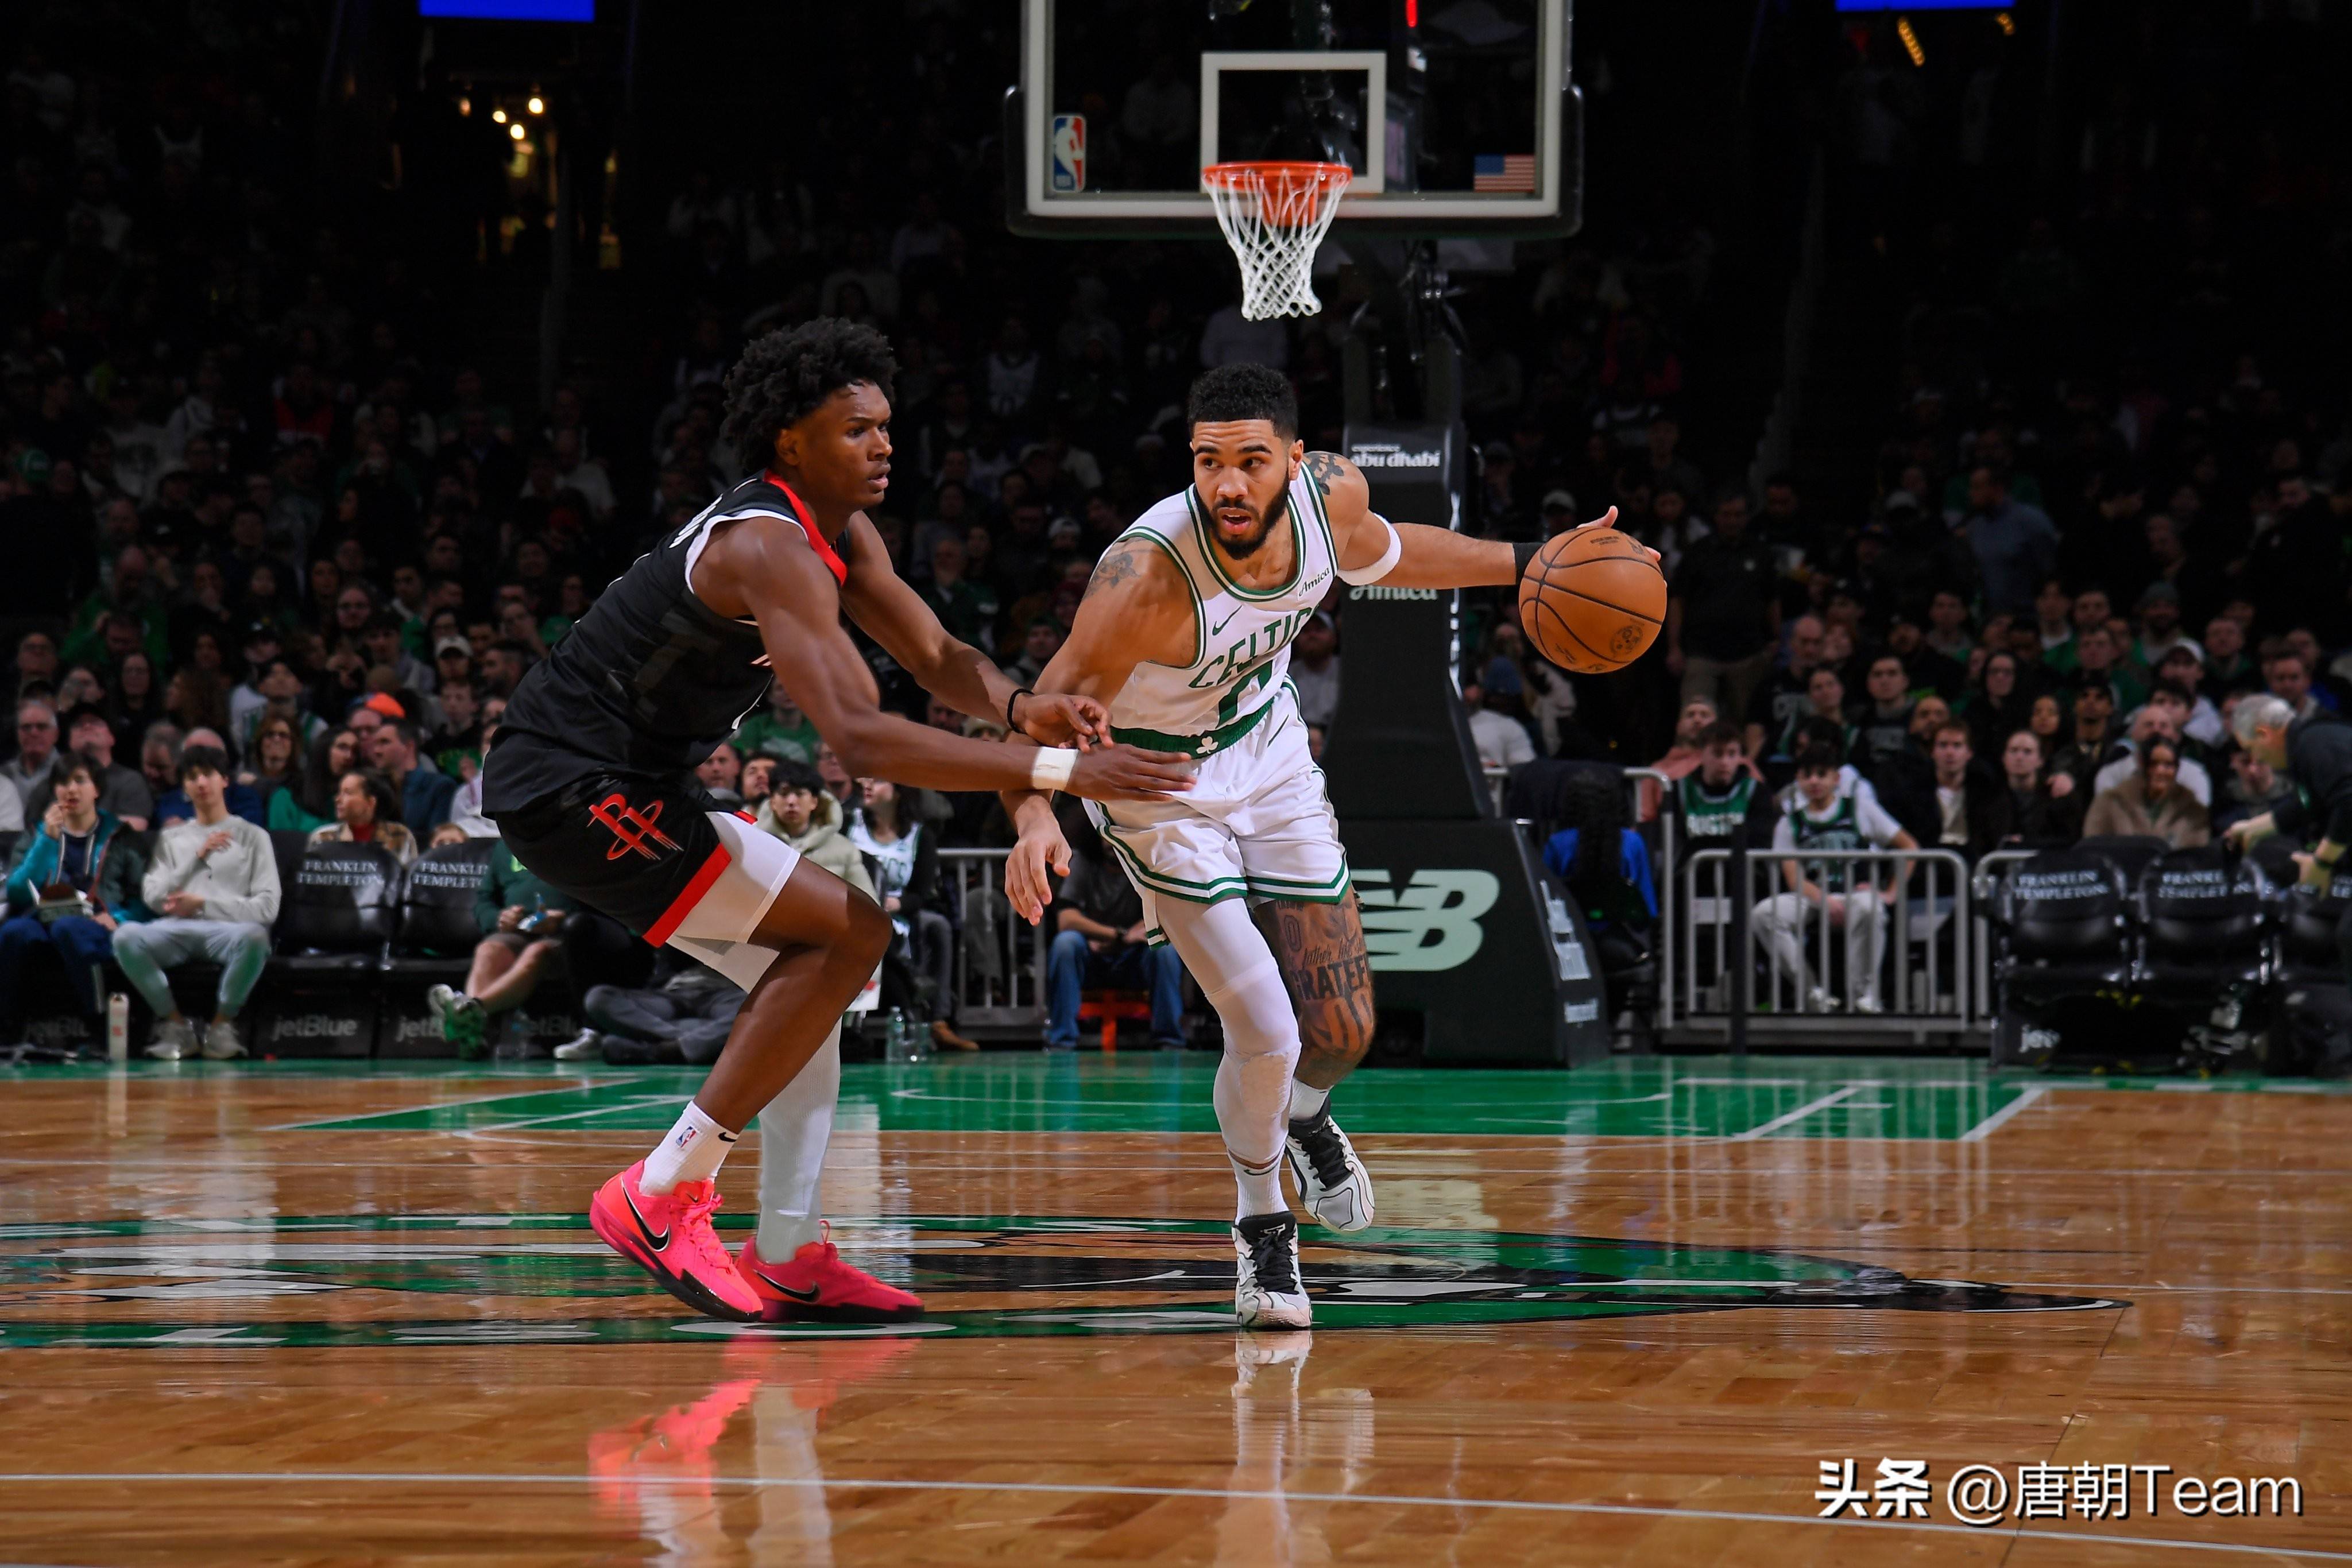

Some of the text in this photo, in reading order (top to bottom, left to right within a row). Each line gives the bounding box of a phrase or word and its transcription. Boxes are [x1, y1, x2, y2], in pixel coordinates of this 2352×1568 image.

[1386, 449, 1442, 467] dhabi
[1299, 567, 1330, 597] Amica
[1187, 603, 1319, 688] CELTIC
[303, 859, 377, 873] FRANKLIN
[296, 872, 386, 888] TEMPLETON
[2018, 869, 2098, 887] FRANKLIN
[2015, 882, 2111, 900] TEMPLETON
[271, 1013, 358, 1042] jetBlue
